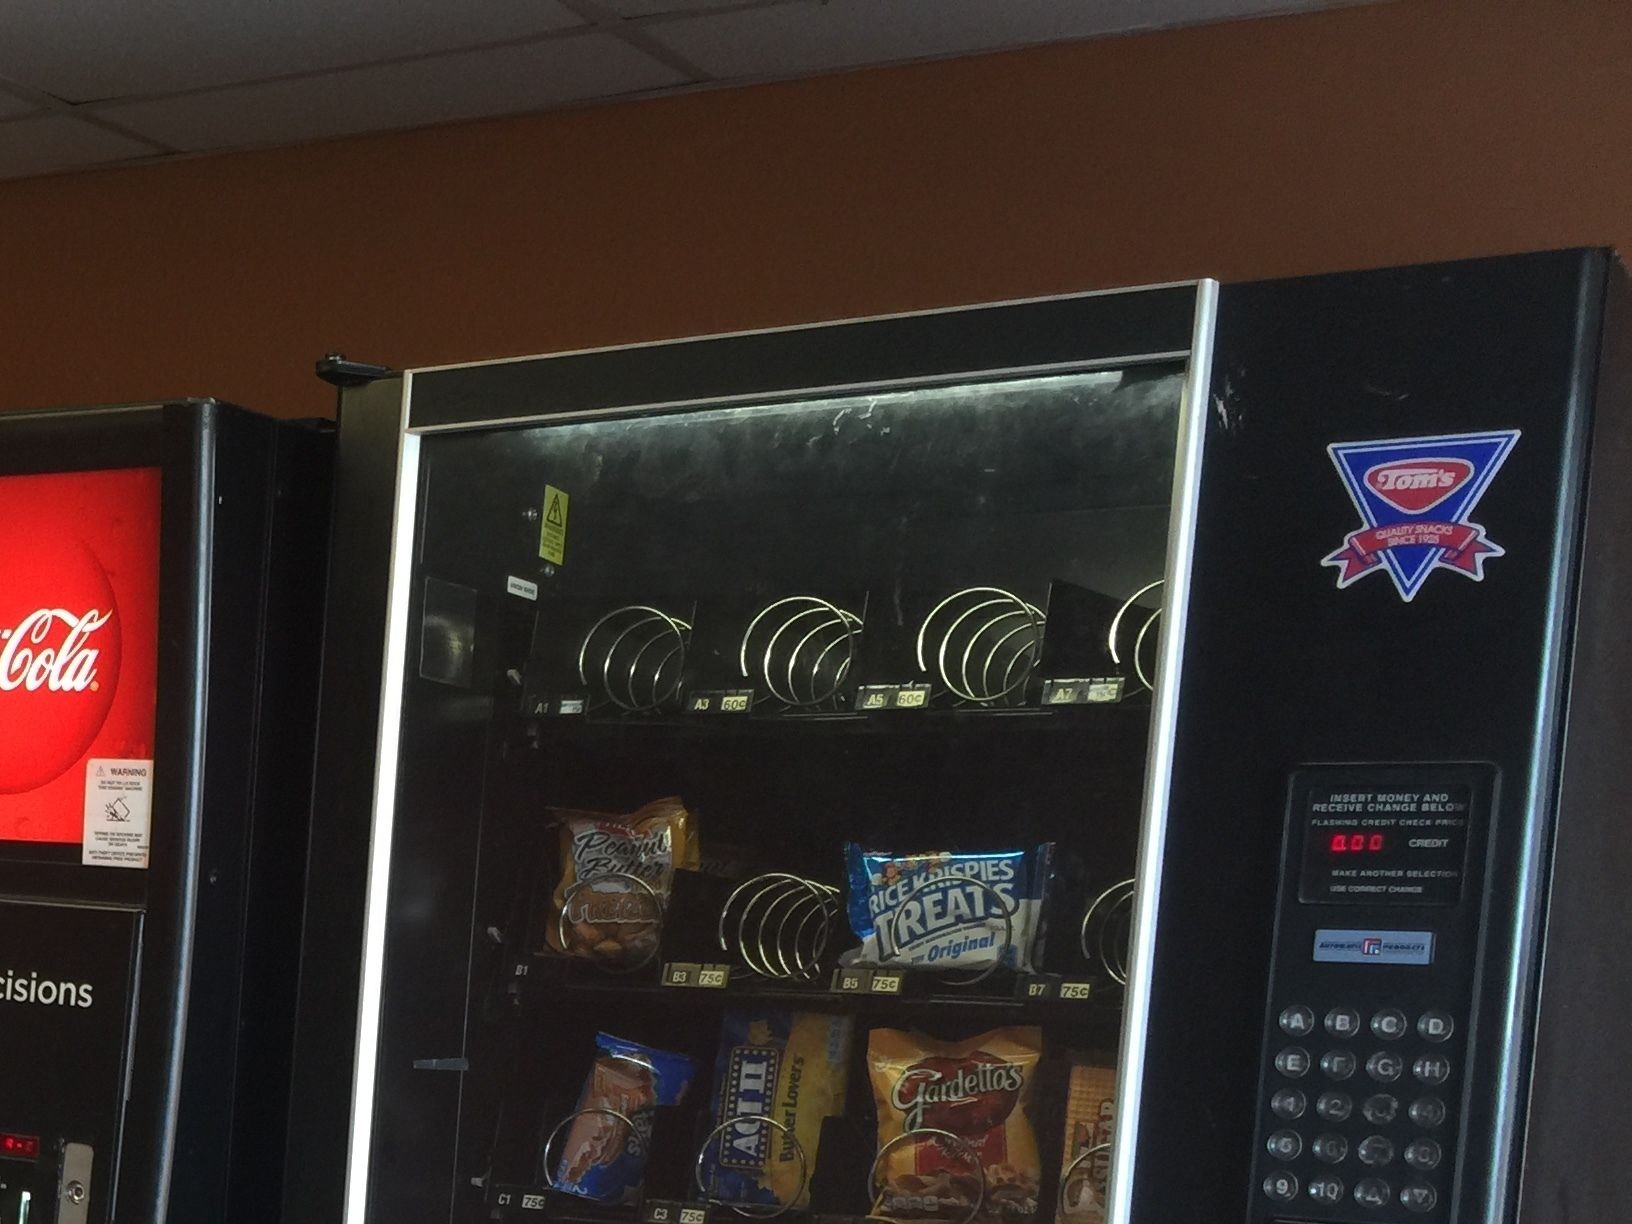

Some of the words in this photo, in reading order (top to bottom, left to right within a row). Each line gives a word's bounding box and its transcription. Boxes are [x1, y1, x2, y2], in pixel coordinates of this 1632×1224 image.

[1377, 467, 1456, 491] Tom's
[1375, 526, 1414, 540] QUALITY
[1414, 524, 1453, 536] SNACKS
[1387, 536, 1415, 546] SINCE
[868, 693, 884, 706] A5
[1055, 688, 1073, 700] A7
[694, 698, 710, 711] A3
[110, 767, 147, 777] WARNING
[1330, 793, 1373, 802] INSERT
[1377, 793, 1419, 802] MONEY
[1423, 793, 1449, 802] AND
[1312, 803, 1363, 812] RECEIVE
[1367, 803, 1417, 812] CHANGE
[575, 830, 670, 862] Peanut
[1408, 838, 1449, 848] CREDIT
[580, 856, 665, 880] Butter
[1331, 869, 1357, 877] MAKE
[869, 876, 912, 916] RICE
[913, 859, 1015, 892] KRISPIES
[872, 882, 1019, 961] TREATS
[928, 931, 996, 962] Original
[672, 971, 687, 983] B3
[843, 977, 859, 990] B5
[1029, 983, 1045, 997] B7
[1290, 1013, 1305, 1029] A
[1336, 1015, 1350, 1031] B
[1381, 1016, 1397, 1033] C
[1429, 1018, 1444, 1034] D
[1286, 1054, 1301, 1071] E
[1377, 1058, 1394, 1075] G
[1424, 1060, 1440, 1078] H
[782, 1055, 804, 1108] Lovers
[892, 1063, 1024, 1133] Gardetto's
[733, 1097, 763, 1157] ACT
[498, 1193, 511, 1206] C1
[653, 1208, 668, 1221] C3
